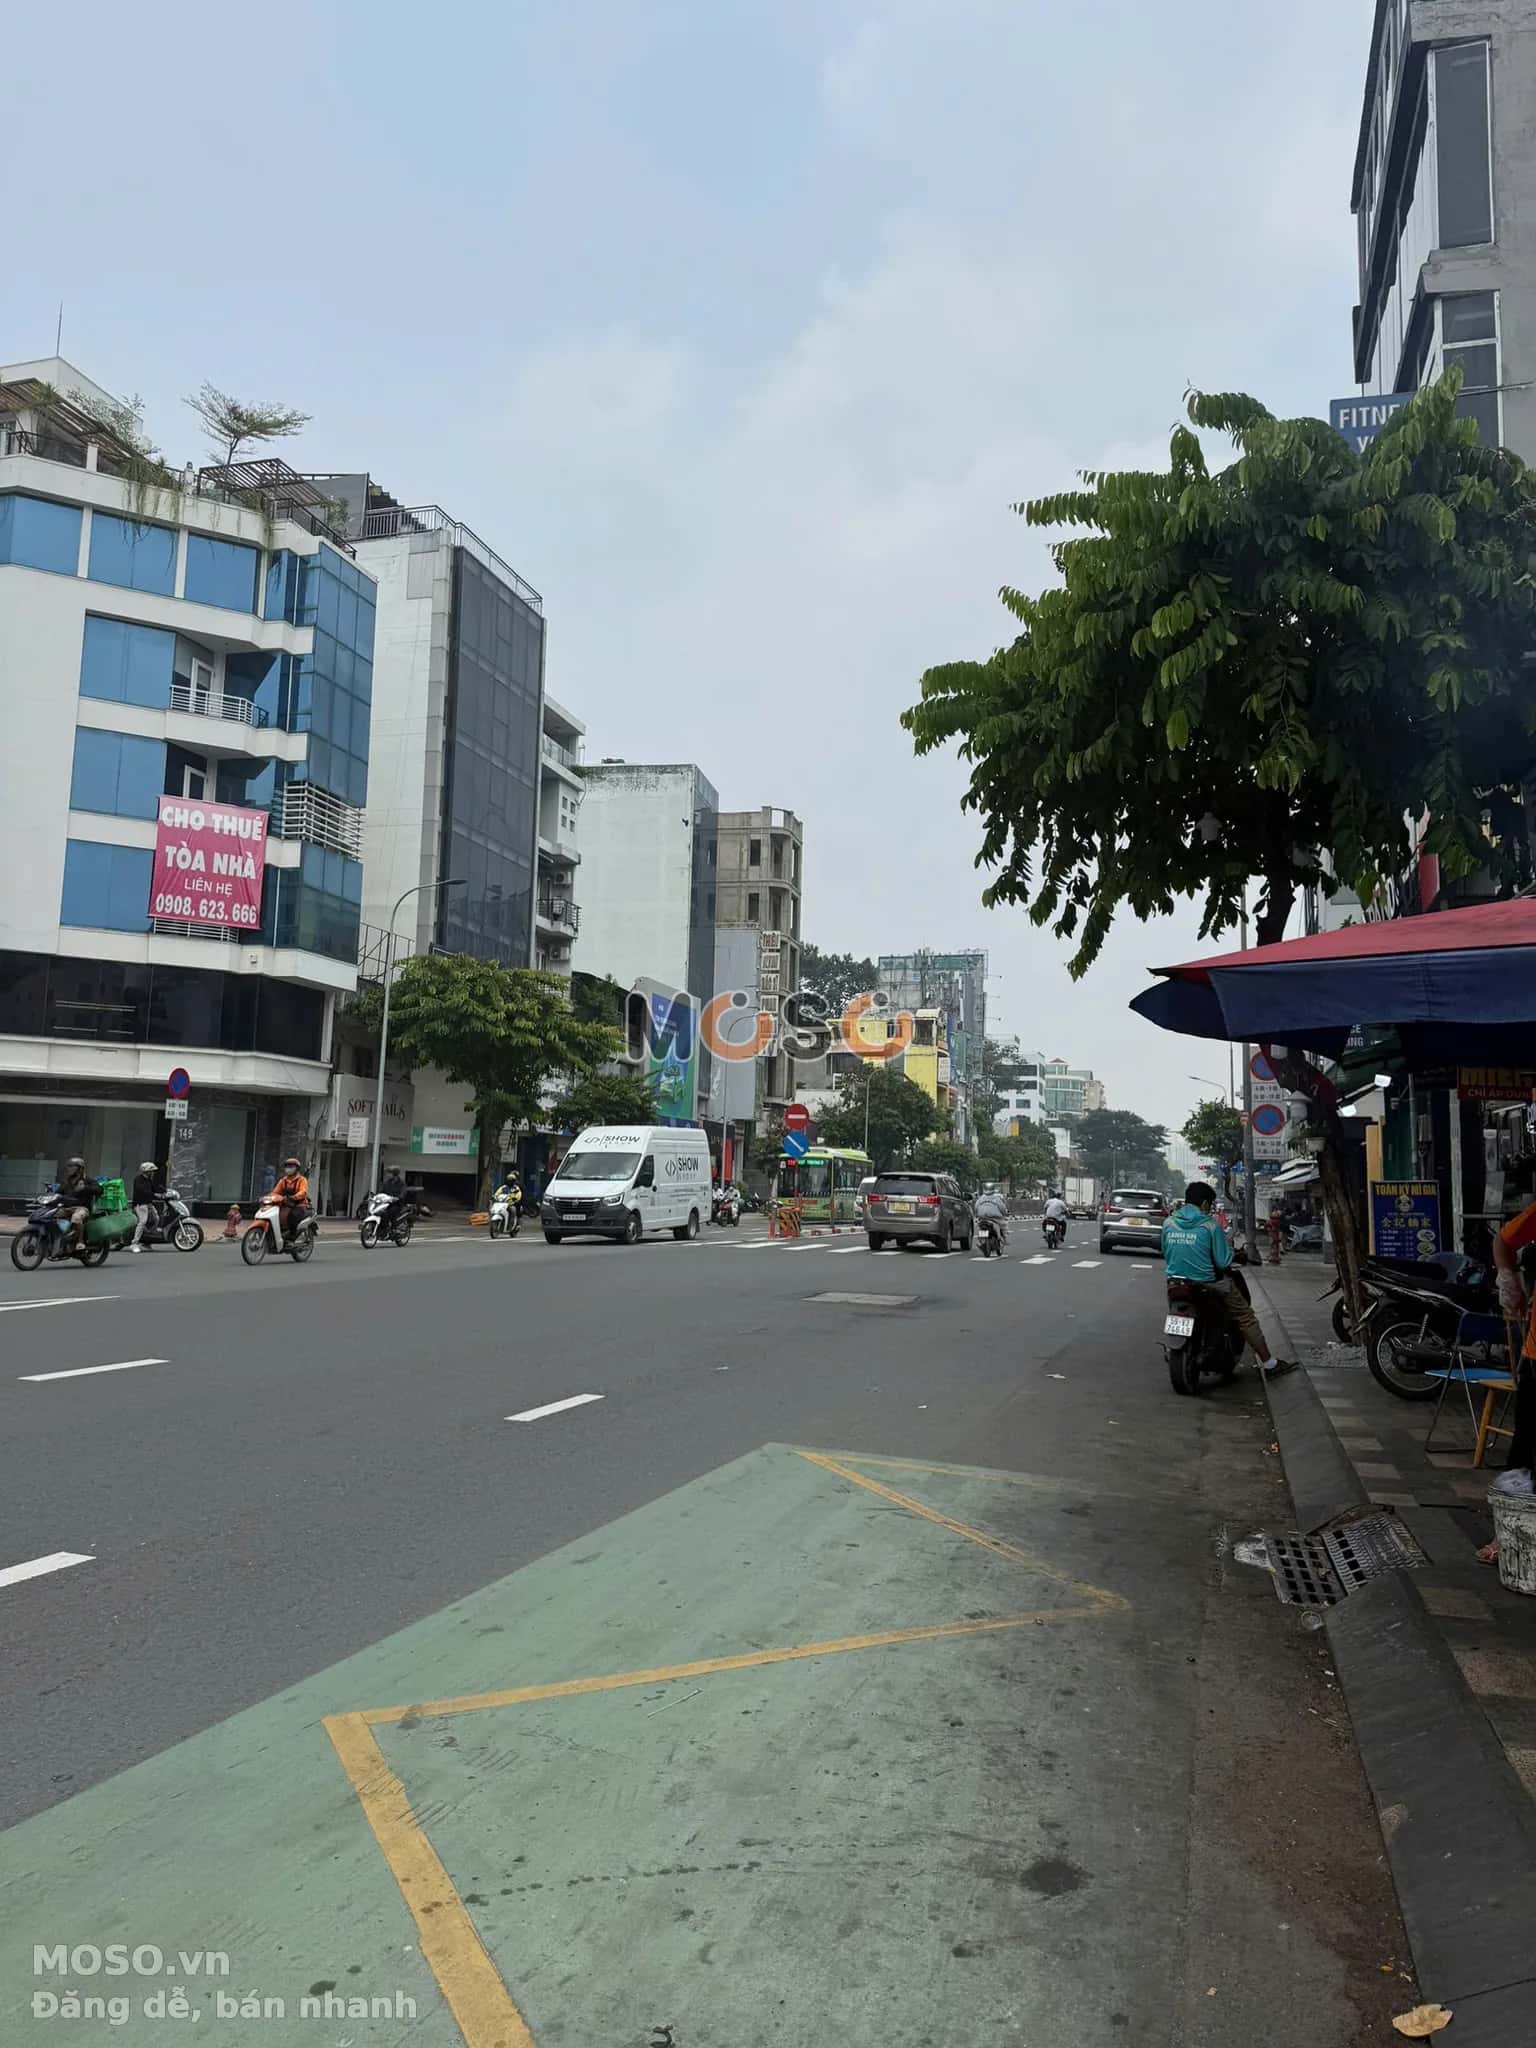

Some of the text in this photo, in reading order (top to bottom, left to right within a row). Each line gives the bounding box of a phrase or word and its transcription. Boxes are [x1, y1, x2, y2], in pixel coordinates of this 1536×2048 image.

[161, 806, 205, 831] CHO
[165, 841, 256, 879] TÒA NHÀ
[232, 904, 257, 924] 666
[347, 1098, 407, 1120] SOFT AILS
[604, 1135, 641, 1143] SHOW
[678, 1156, 699, 1171] SHOW
